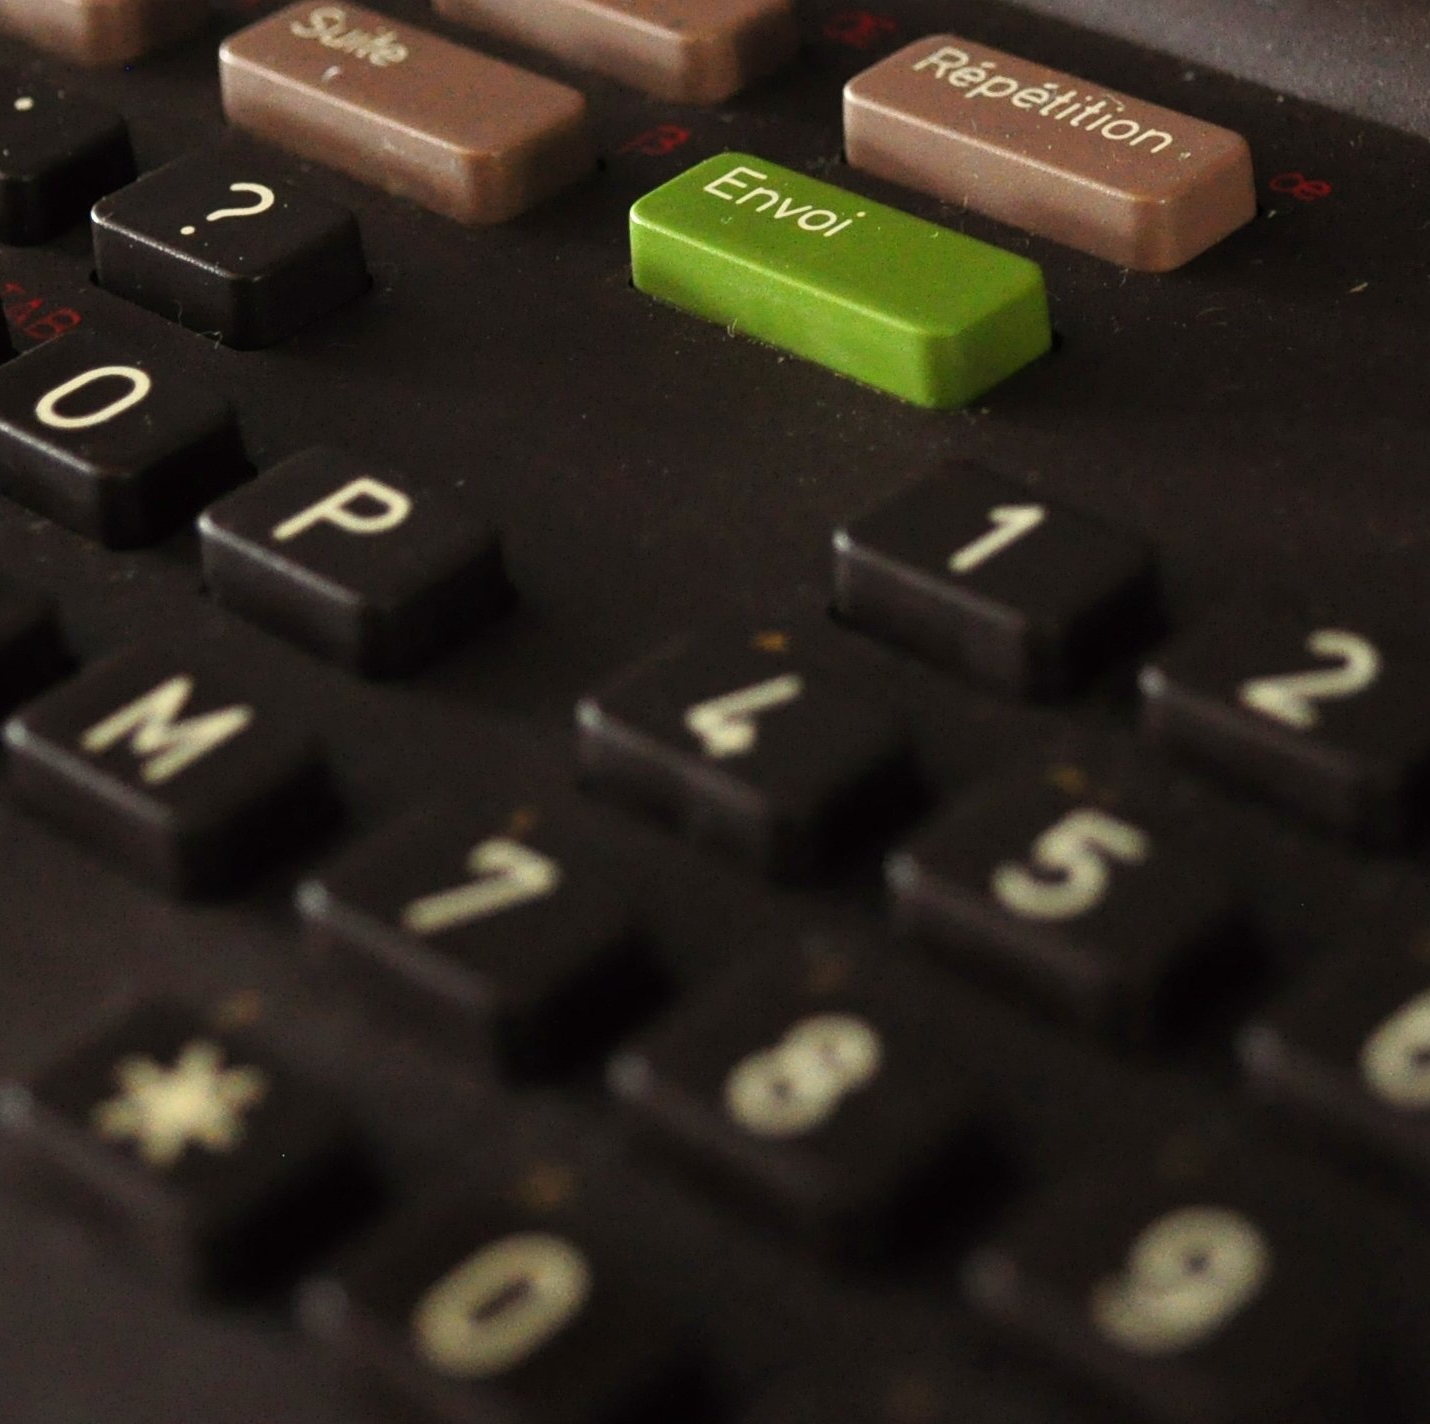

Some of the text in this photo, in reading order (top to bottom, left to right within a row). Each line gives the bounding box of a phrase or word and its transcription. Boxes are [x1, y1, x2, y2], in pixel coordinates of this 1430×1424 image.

[289, 5, 409, 67] Suite
[912, 44, 1173, 145] Répétition
[179, 181, 275, 236] ?
[702, 165, 867, 238] Envoi
[34, 365, 152, 430] O
[273, 477, 412, 541] P
[949, 504, 1047, 573] 1
[683, 673, 803, 760] 4
[1239, 629, 1382, 729] 2
[81, 674, 254, 784] M
[992, 808, 1148, 920] 5
[723, 1013, 882, 1139] 8
[411, 1229, 593, 1376] 0
[1091, 1205, 1268, 1353] 9
